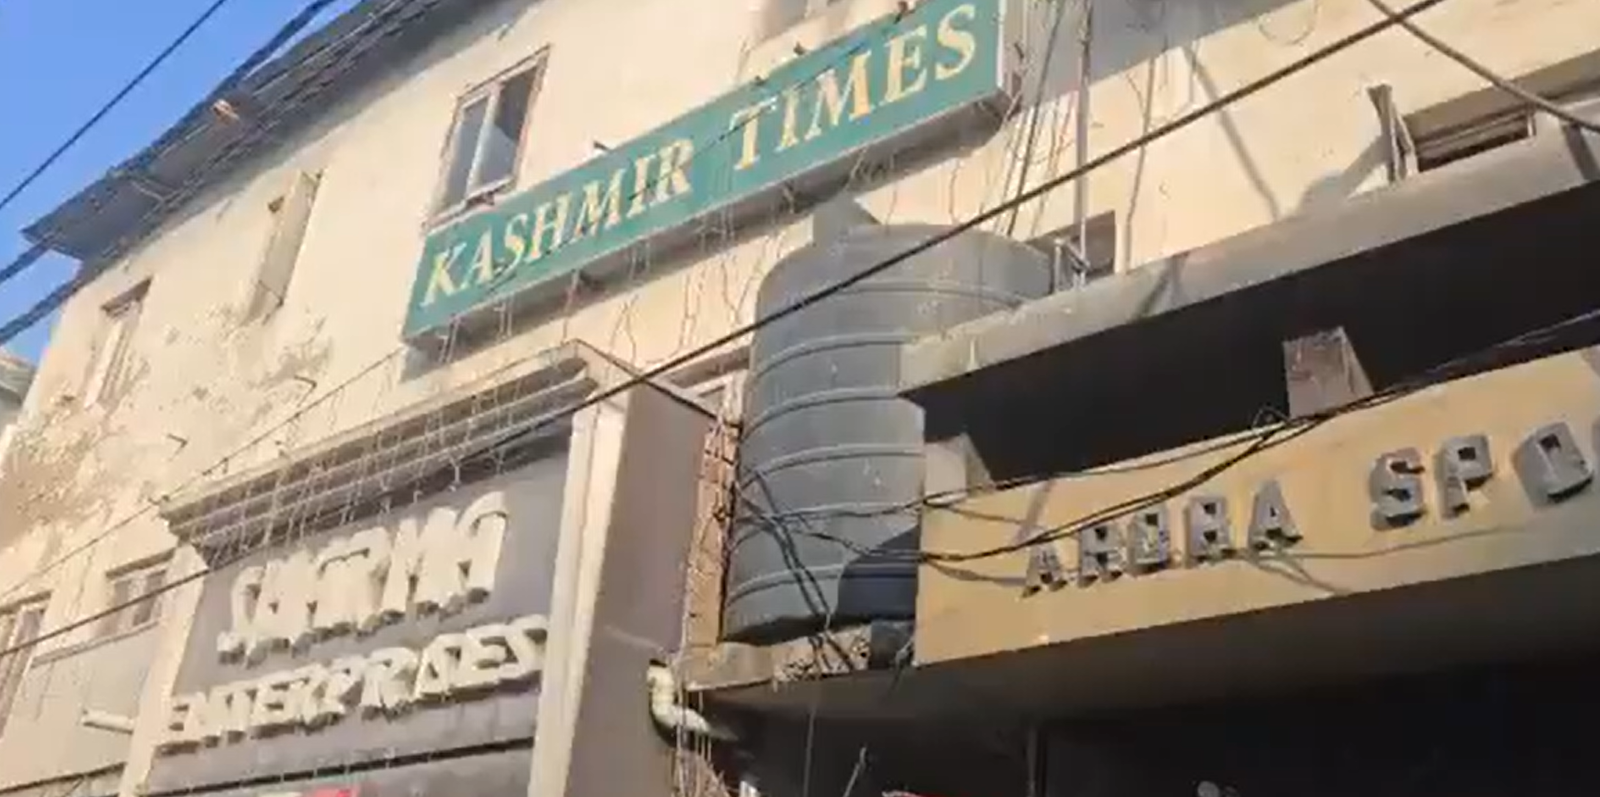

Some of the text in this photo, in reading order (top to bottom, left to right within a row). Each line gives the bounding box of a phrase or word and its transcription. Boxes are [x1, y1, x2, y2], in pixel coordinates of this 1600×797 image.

[419, 4, 976, 308] KASHMIR TIMES
[1368, 415, 1600, 532] SPO
